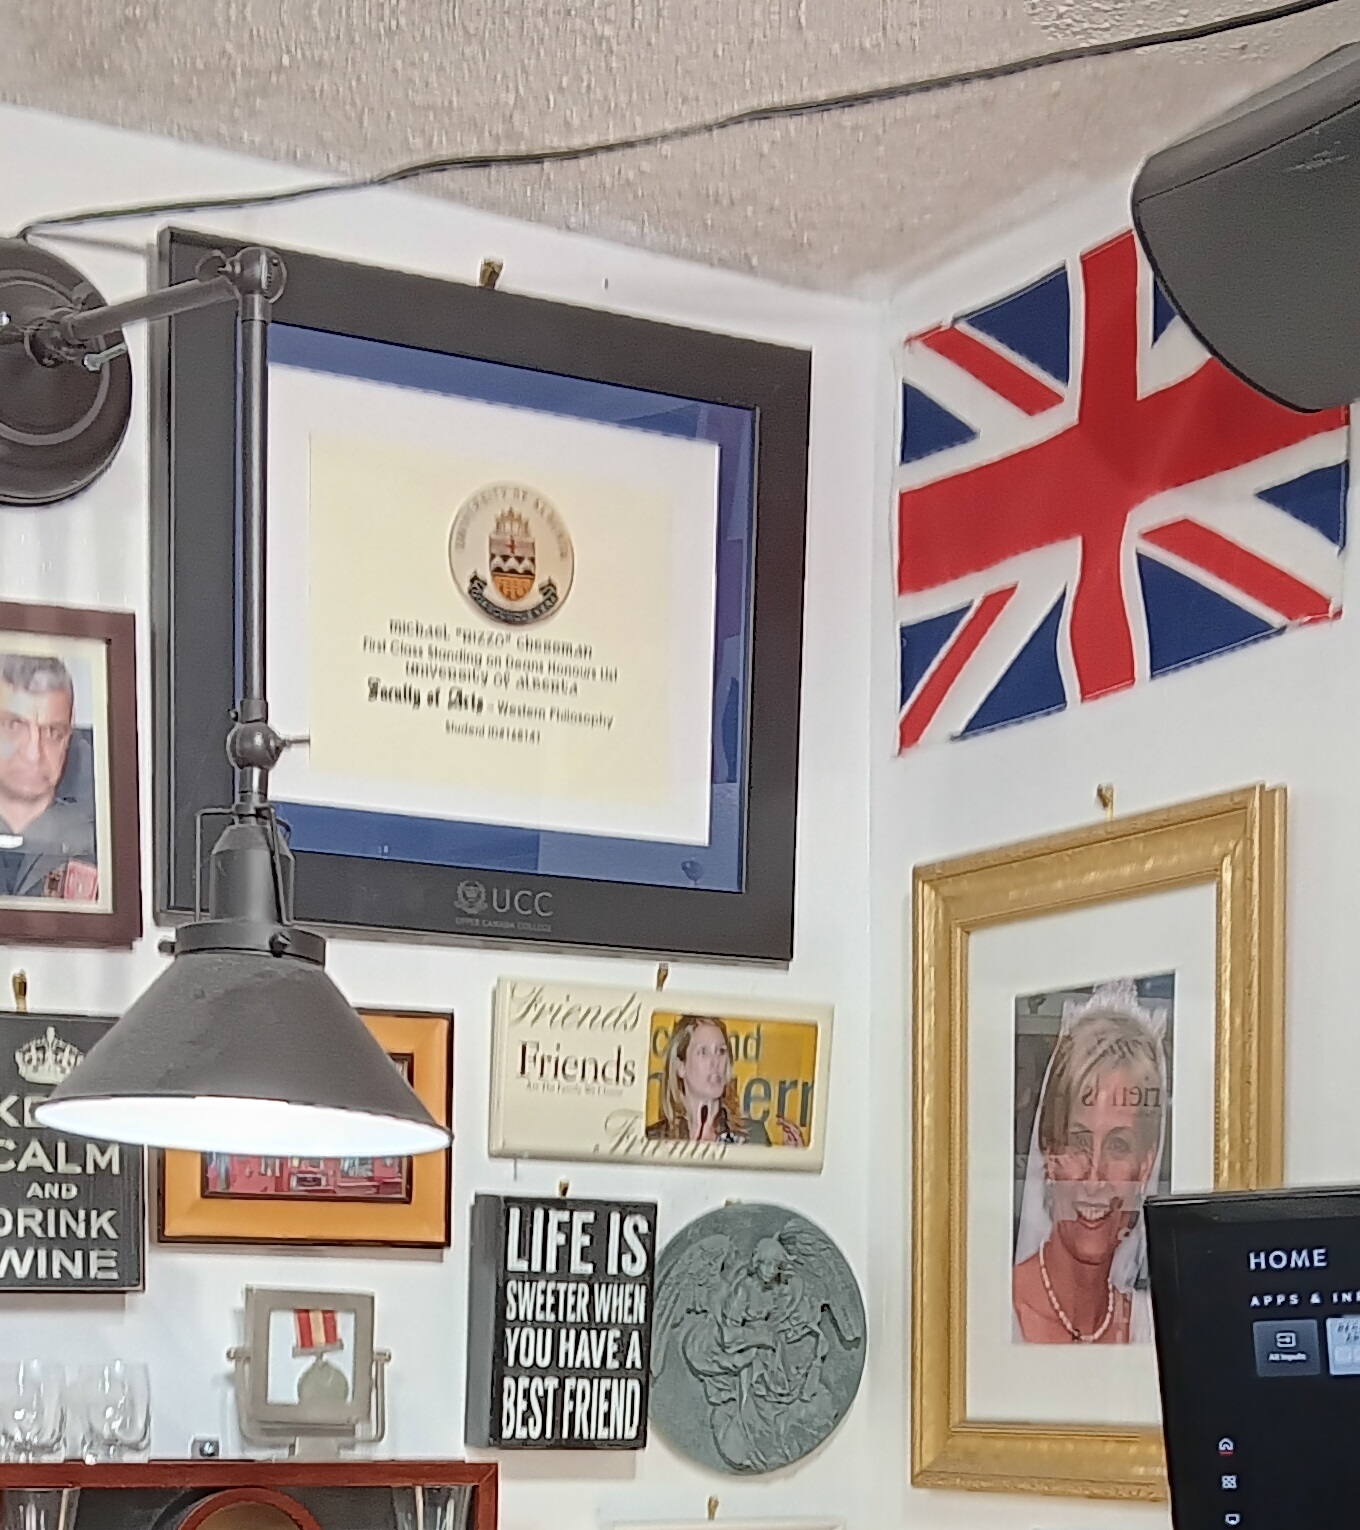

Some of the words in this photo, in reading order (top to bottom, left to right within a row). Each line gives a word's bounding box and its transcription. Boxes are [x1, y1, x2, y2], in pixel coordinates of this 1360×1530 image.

[492, 887, 554, 917] UCC
[510, 982, 642, 1033] Friends
[518, 1039, 637, 1088] Friends
[26, 1181, 79, 1200] AND
[507, 1206, 596, 1275] LIFE
[607, 1211, 650, 1277] IS
[1248, 1248, 1328, 1270] HOME
[505, 1279, 590, 1323] SWEETER
[593, 1283, 647, 1325] WHEN
[1250, 1293, 1300, 1308] APPS
[1310, 1292, 1322, 1304] &
[505, 1327, 553, 1368] YOU
[557, 1328, 621, 1370] HAVE
[625, 1329, 643, 1370] A
[501, 1375, 560, 1440] BEST
[561, 1376, 641, 1441] FRIEND
